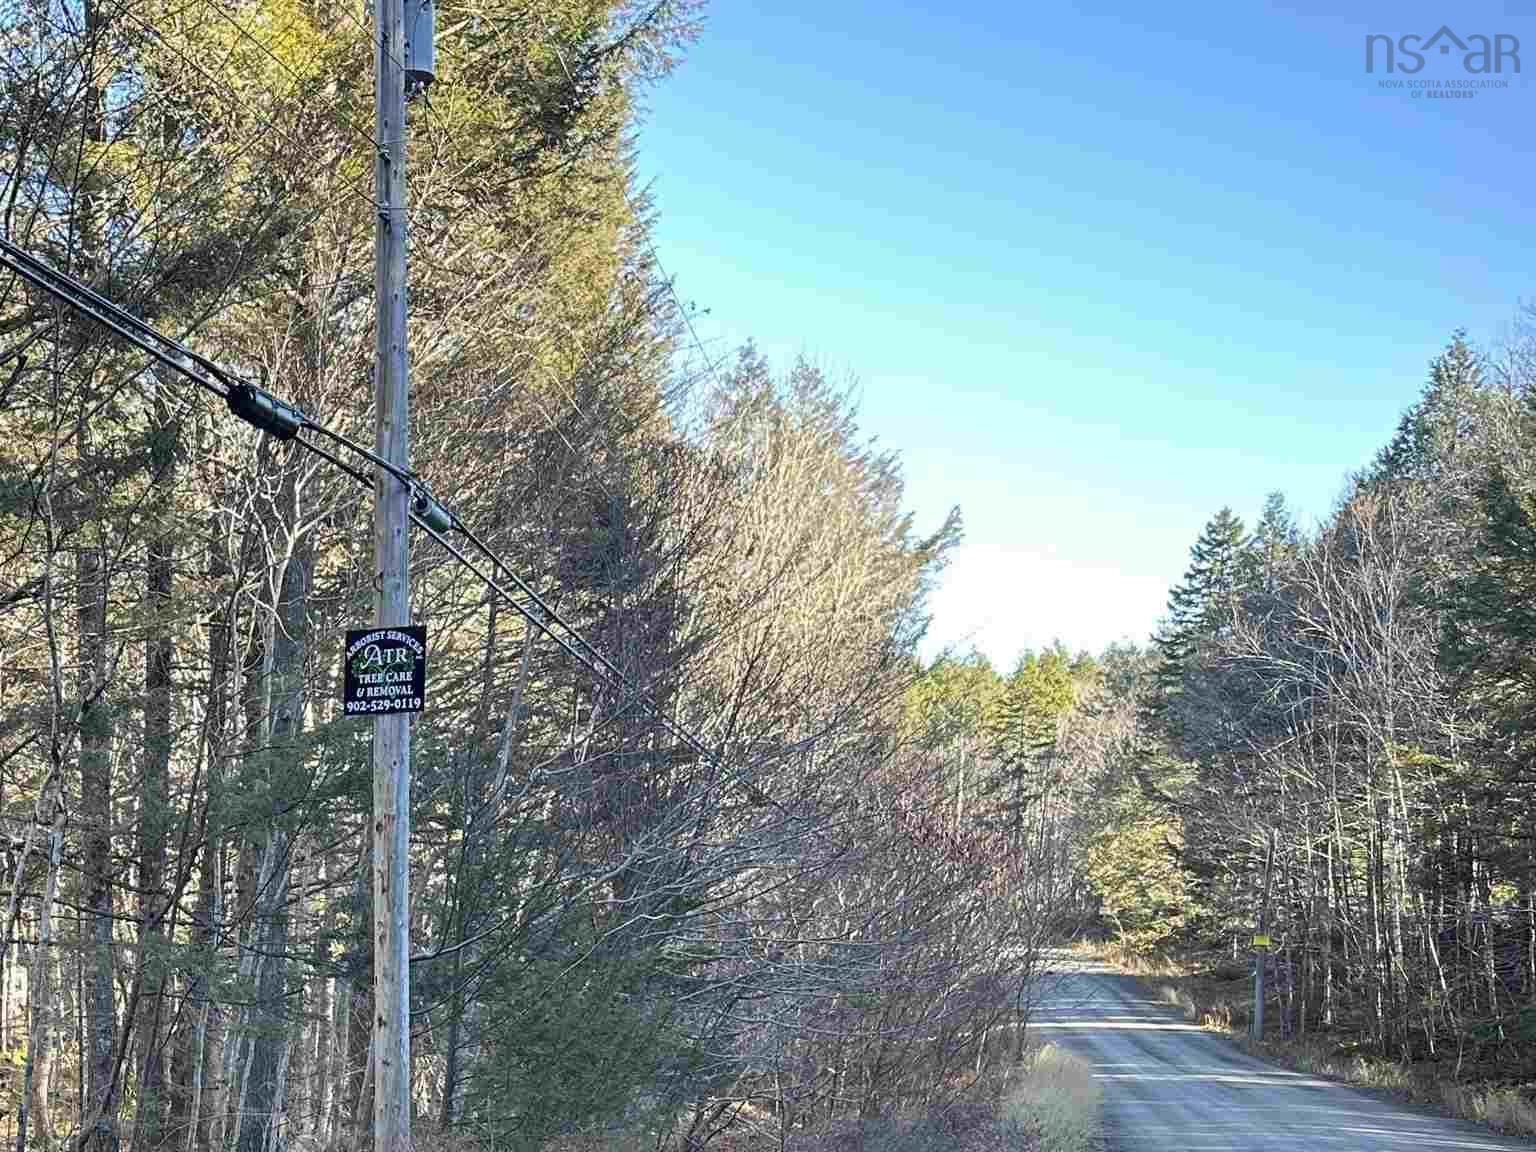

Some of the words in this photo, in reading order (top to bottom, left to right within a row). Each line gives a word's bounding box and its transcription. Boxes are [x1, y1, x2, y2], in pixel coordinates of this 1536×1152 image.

[346, 631, 386, 660] ARBORIST
[358, 672, 385, 684] TREE
[386, 671, 413, 682] CARE
[356, 687, 365, 698] &
[366, 685, 414, 697] REMOVAL
[346, 697, 421, 713] 902-529-0119
